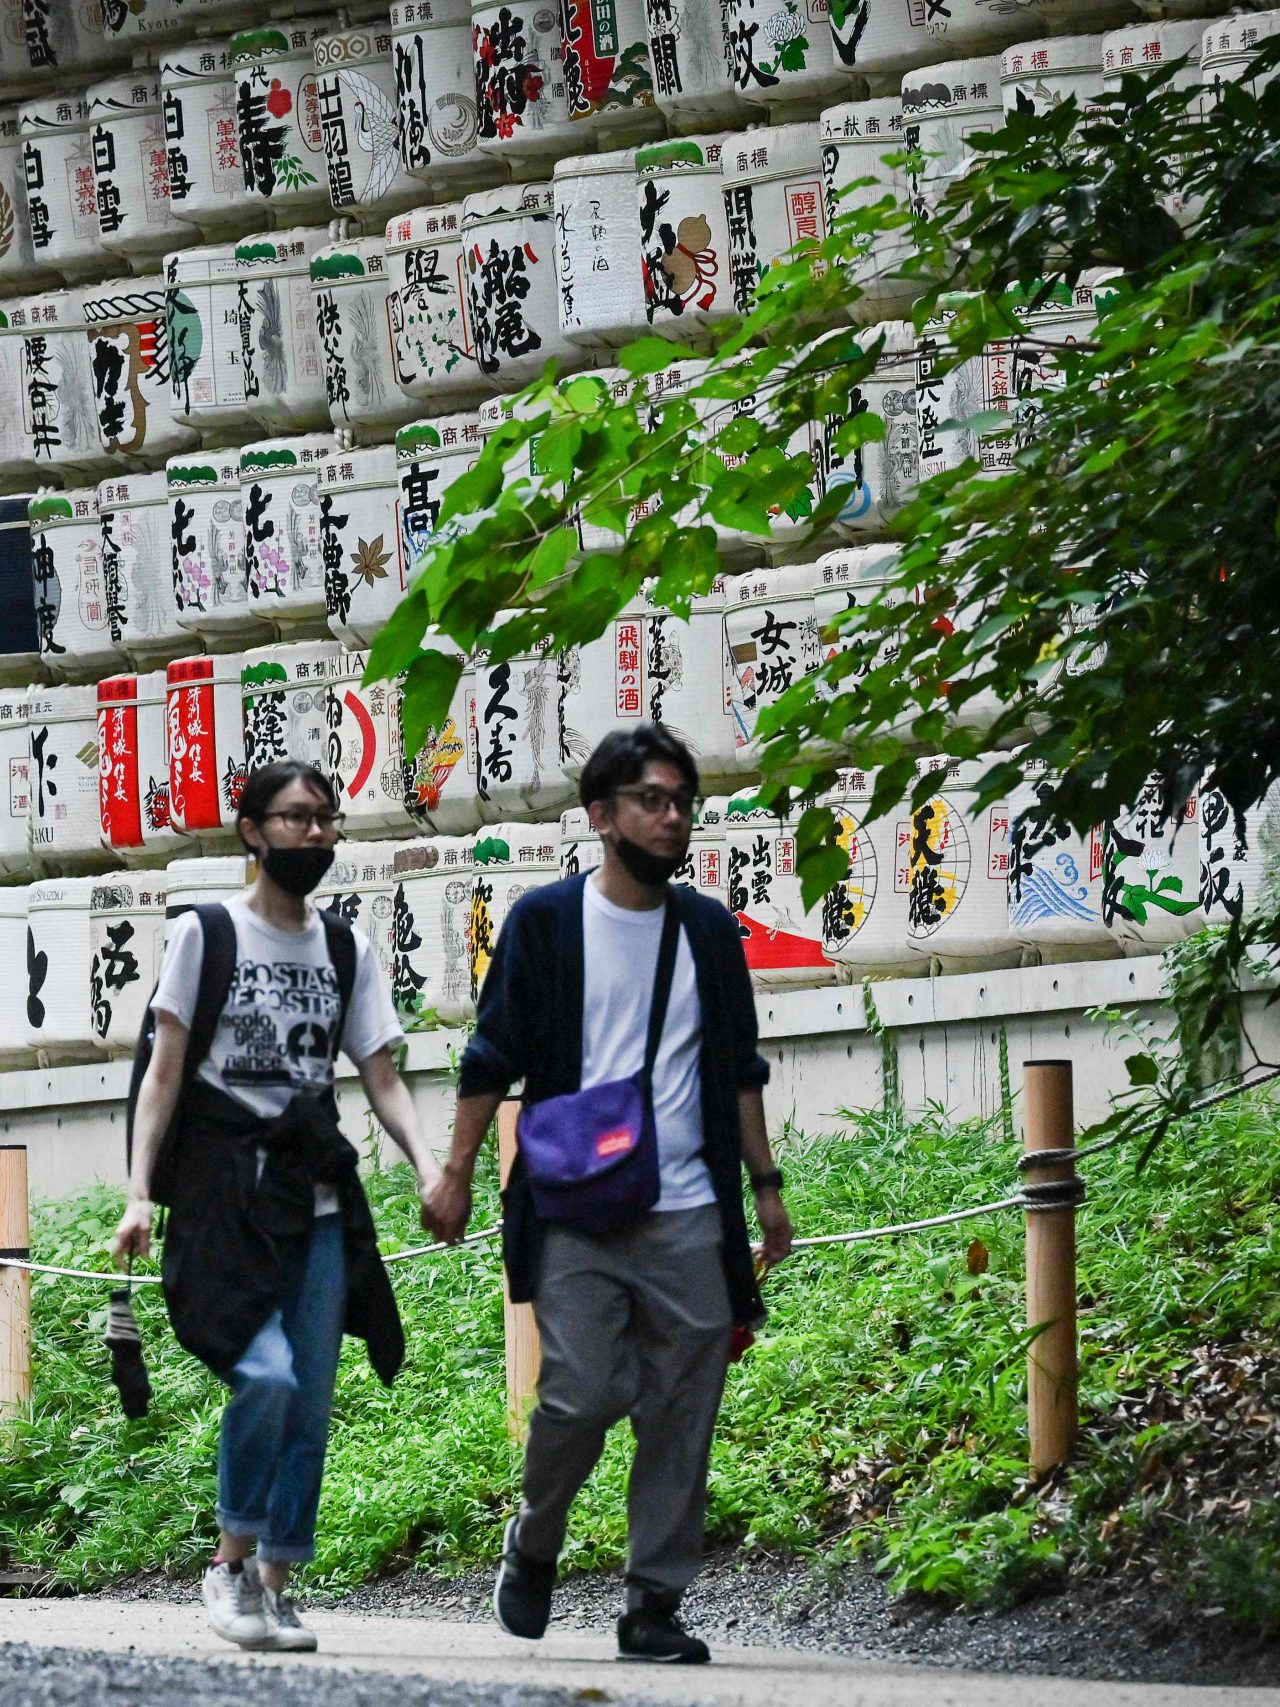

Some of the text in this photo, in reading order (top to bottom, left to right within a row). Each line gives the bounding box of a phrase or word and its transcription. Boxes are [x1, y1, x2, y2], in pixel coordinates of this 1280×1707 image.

[405, 2, 434, 22] 商標
[137, 17, 178, 32] Kyoto
[1219, 28, 1258, 50] 商標
[1010, 51, 1049, 71] 商標
[1120, 42, 1162, 65] 商標
[952, 83, 989, 101] 商標
[166, 90, 195, 200] 白雪
[216, 119, 241, 171] 萬歳紋
[318, 76, 357, 208] 出羽鶴
[736, 147, 769, 172] 商標
[90, 123, 128, 234] 白雪
[24, 141, 58, 249] 白雪
[75, 166, 98, 216] 萬歳紋
[426, 215, 458, 233] 商標
[277, 242, 305, 257] 商標
[367, 255, 383, 272] 商
[30, 305, 57, 324] 商標
[224, 308, 240, 367] 埼玉
[316, 289, 351, 422] 秩父錦
[24, 336, 62, 460] 腰古井
[442, 425, 480, 443] 商標
[327, 462, 355, 481] 商標
[822, 564, 849, 583] 商標
[739, 583, 768, 601] 商標
[618, 624, 639, 711] 飛騨の酒
[837, 771, 866, 792] 商標
[519, 845, 555, 862] 商標
[778, 841, 794, 875] 清酒
[701, 852, 718, 887] 清酒
[752, 834, 772, 905] 出雲
[221, 1009, 272, 1029] ecolo
